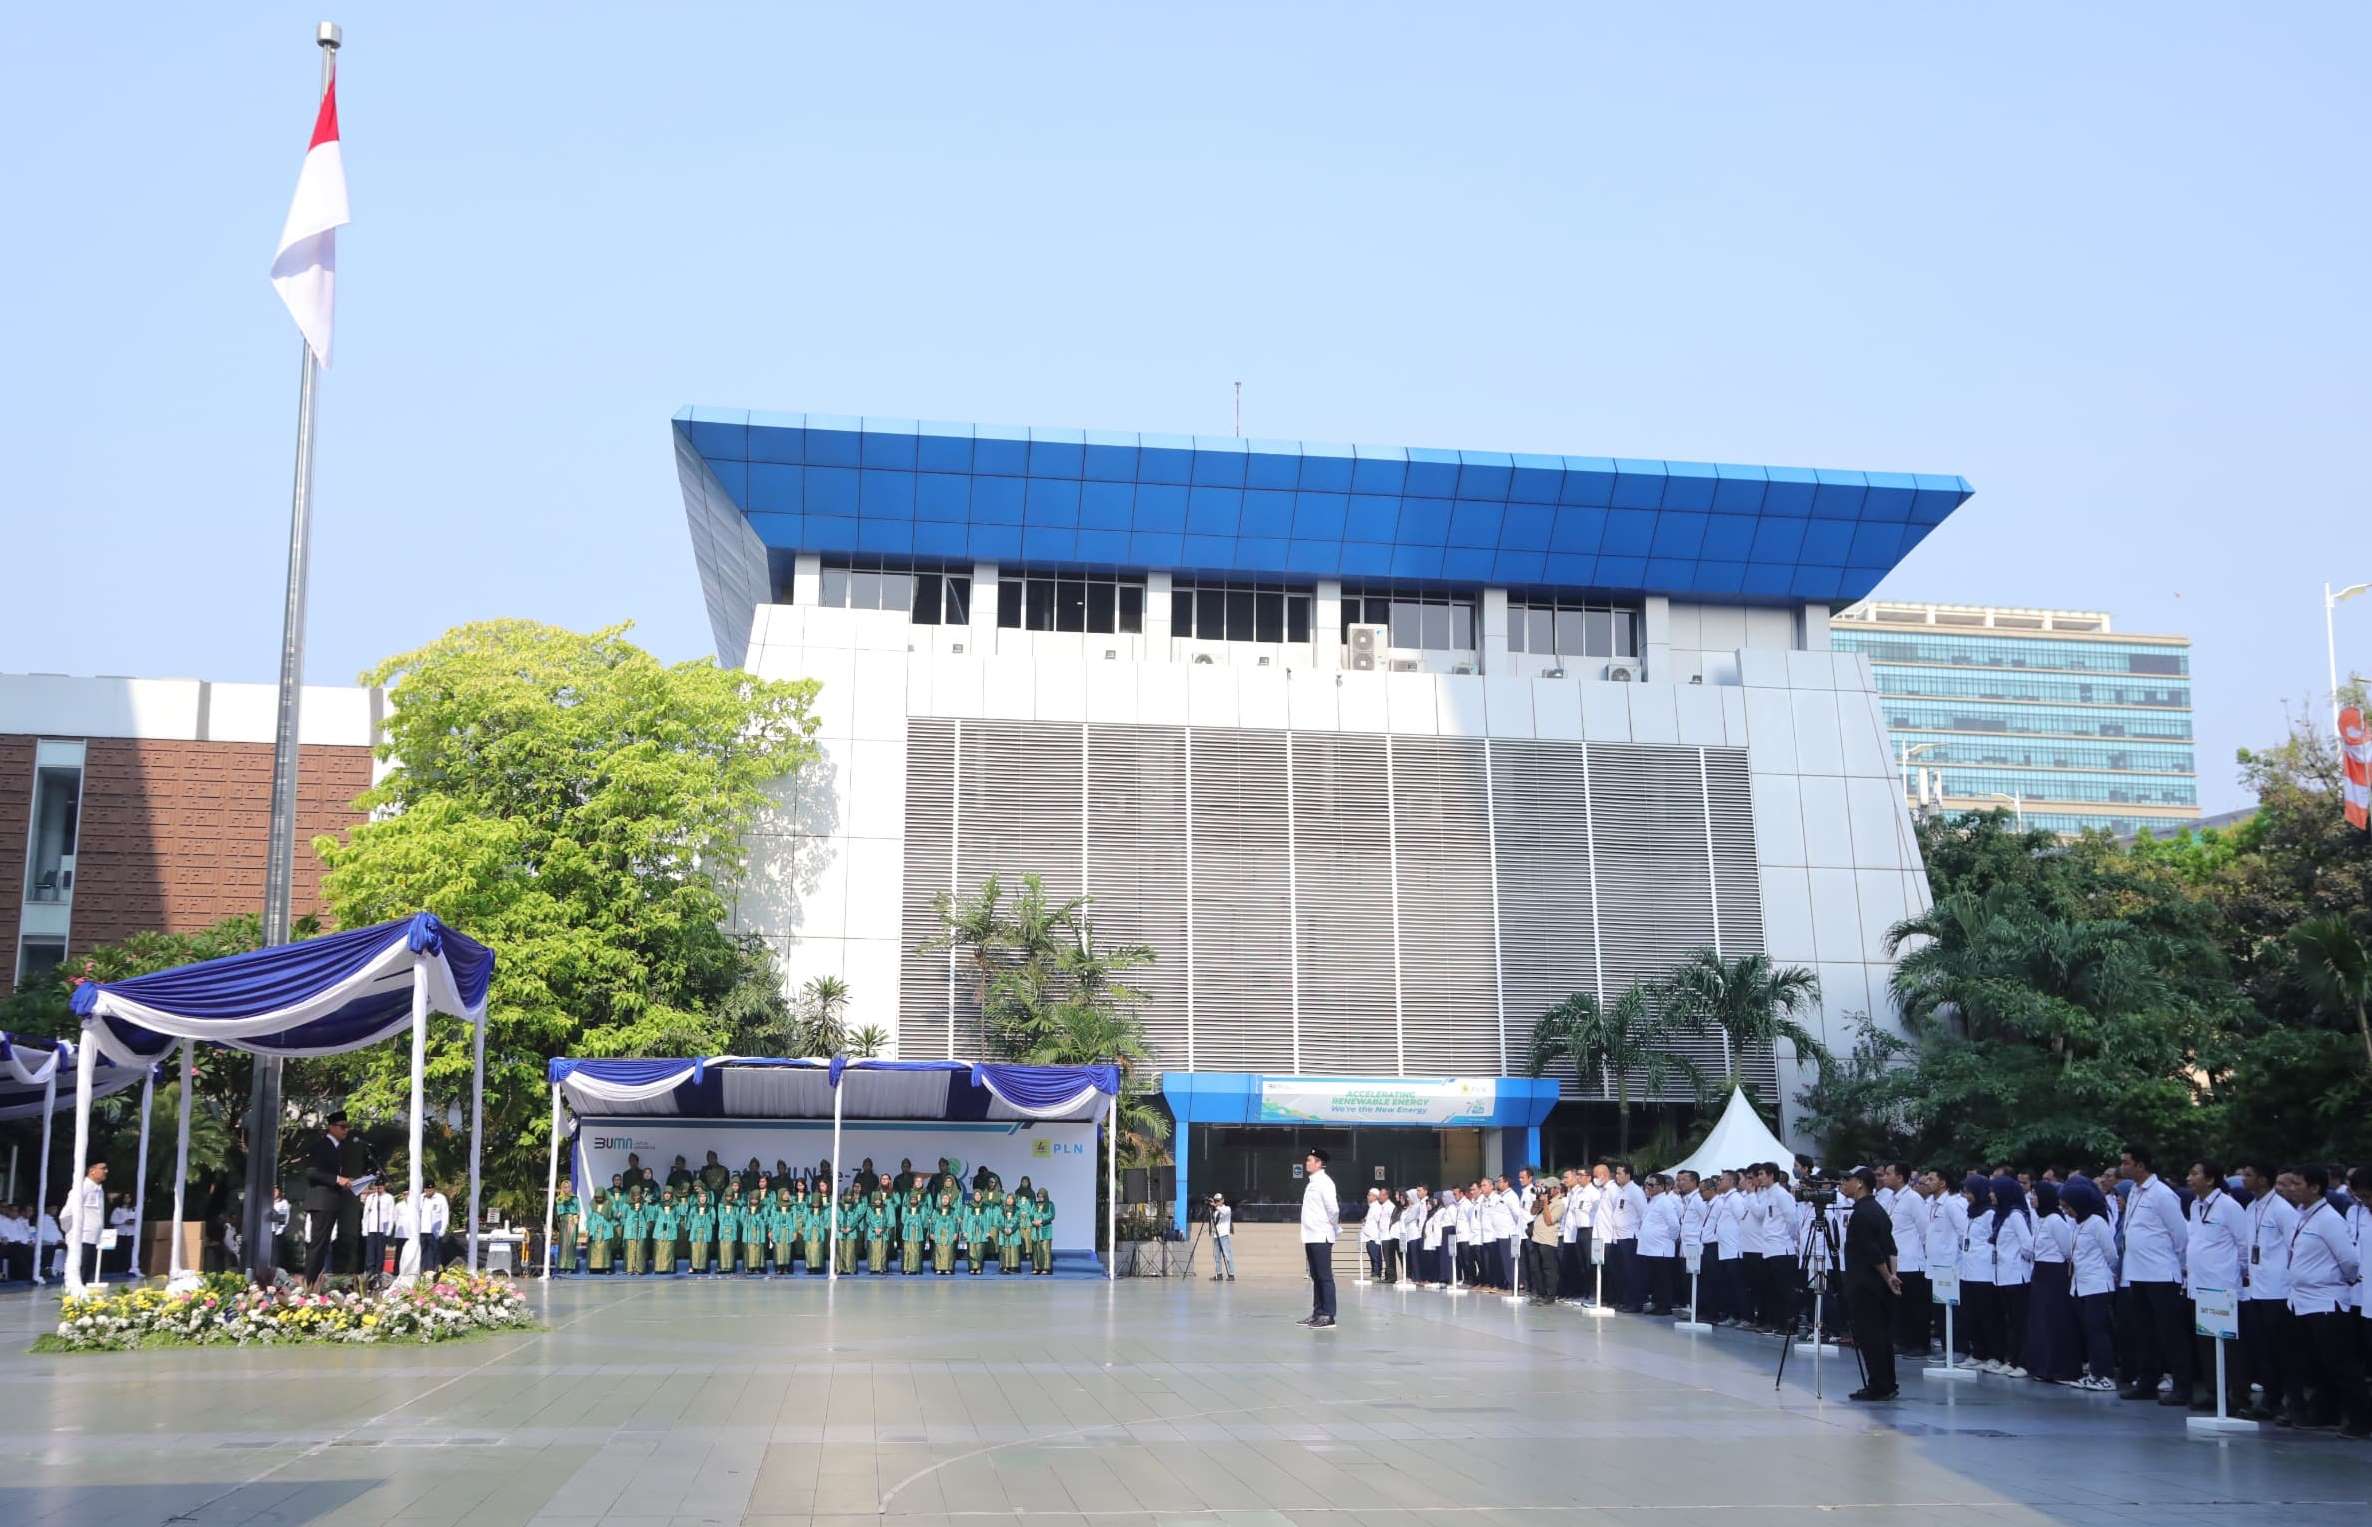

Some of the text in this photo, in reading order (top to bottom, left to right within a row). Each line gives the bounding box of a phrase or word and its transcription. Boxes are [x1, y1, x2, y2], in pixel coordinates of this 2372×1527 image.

[1331, 1097, 1430, 1106] RENEWABLE ENERGY
[1358, 1106, 1374, 1114] the
[1397, 1106, 1428, 1115] Energy
[1053, 1143, 1083, 1154] PLN
